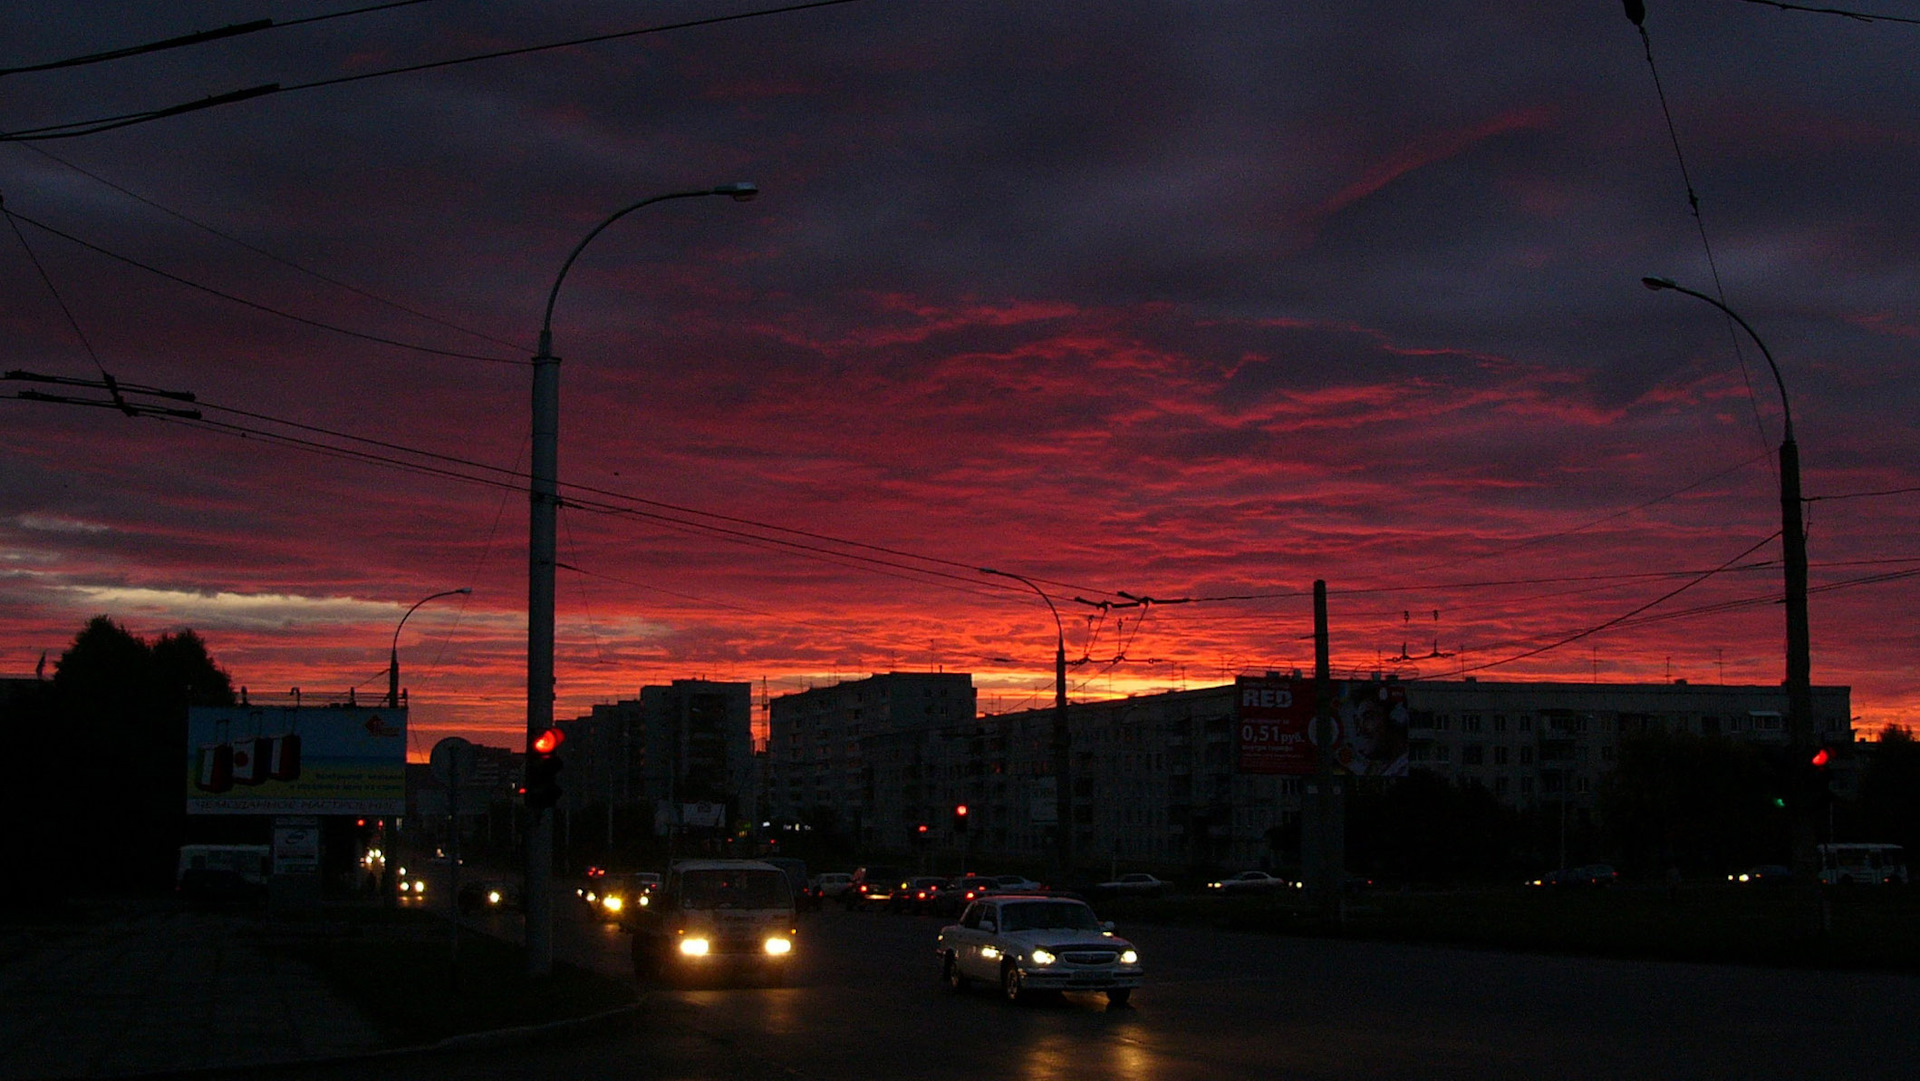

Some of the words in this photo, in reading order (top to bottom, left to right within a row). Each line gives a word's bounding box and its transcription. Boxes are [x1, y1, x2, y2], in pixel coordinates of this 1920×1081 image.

[1242, 689, 1293, 708] RED
[1241, 725, 1279, 743] 0,51
[1280, 731, 1306, 745] руб.
